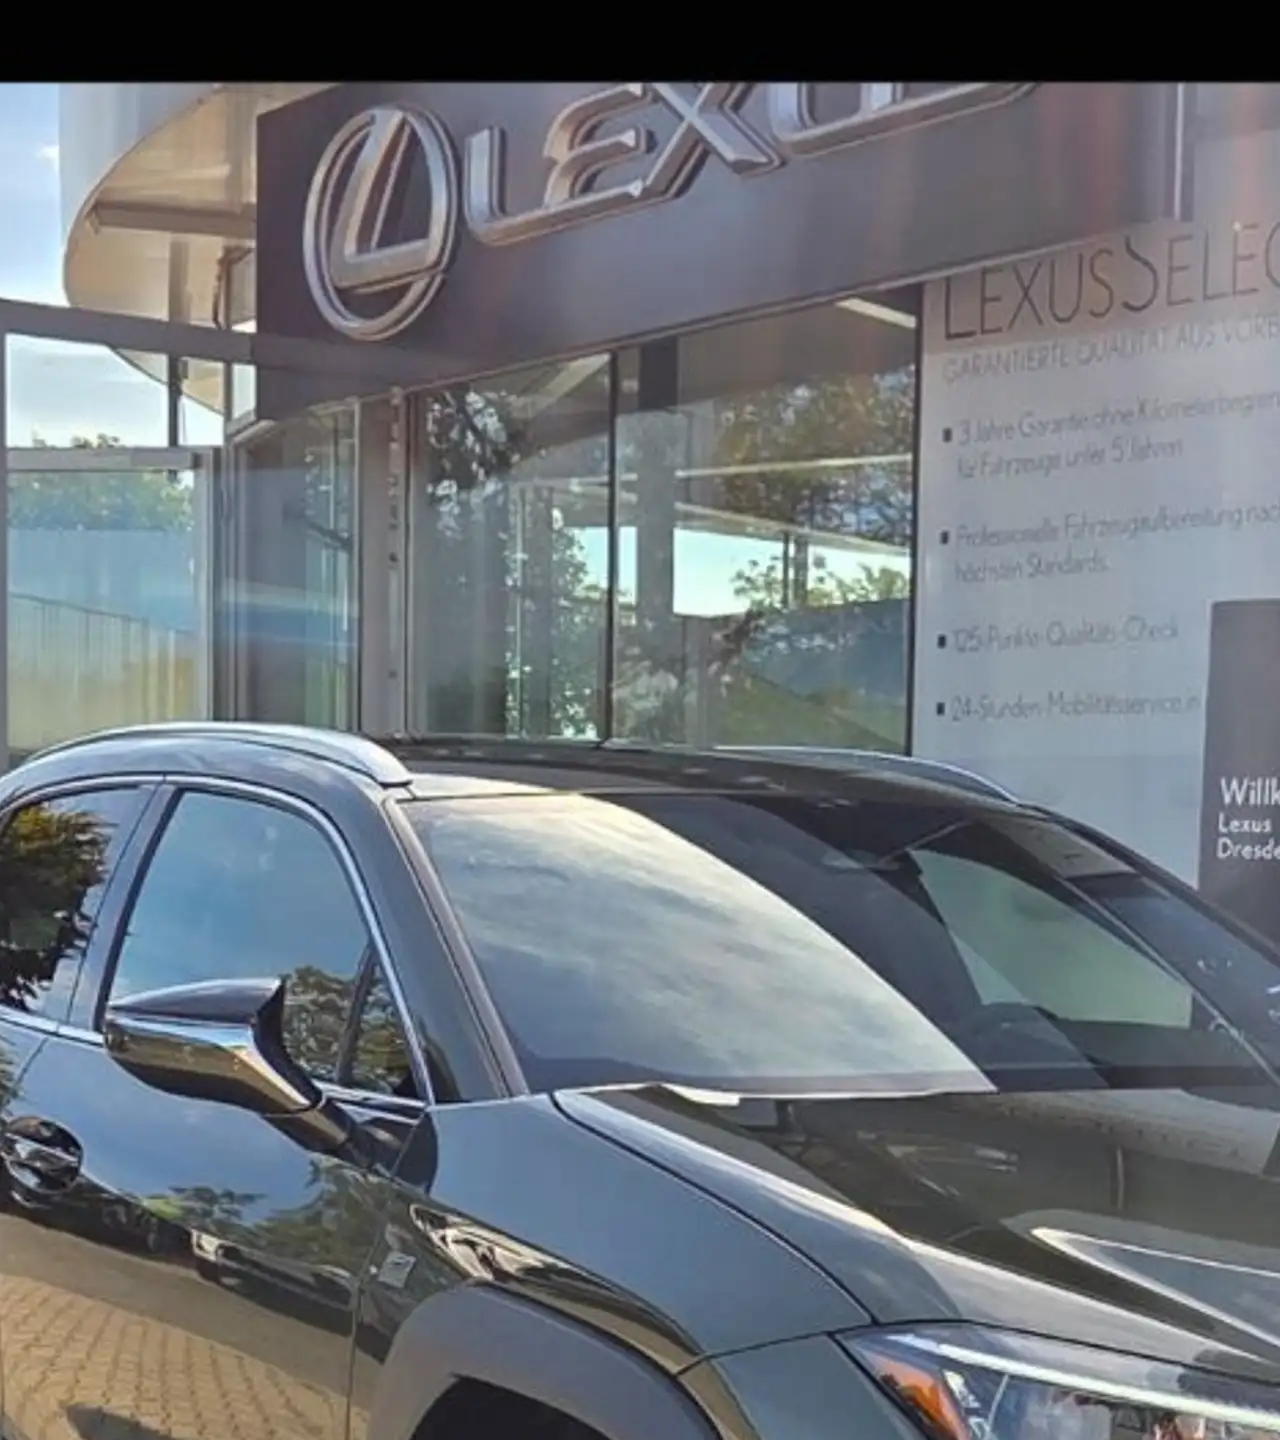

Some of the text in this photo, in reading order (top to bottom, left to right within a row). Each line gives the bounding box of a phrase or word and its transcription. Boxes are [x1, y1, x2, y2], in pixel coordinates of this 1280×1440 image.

[957, 420, 972, 446] 3
[1018, 409, 1088, 440] Garantie
[1111, 435, 1124, 463] 5
[1218, 811, 1273, 834] Lexus
